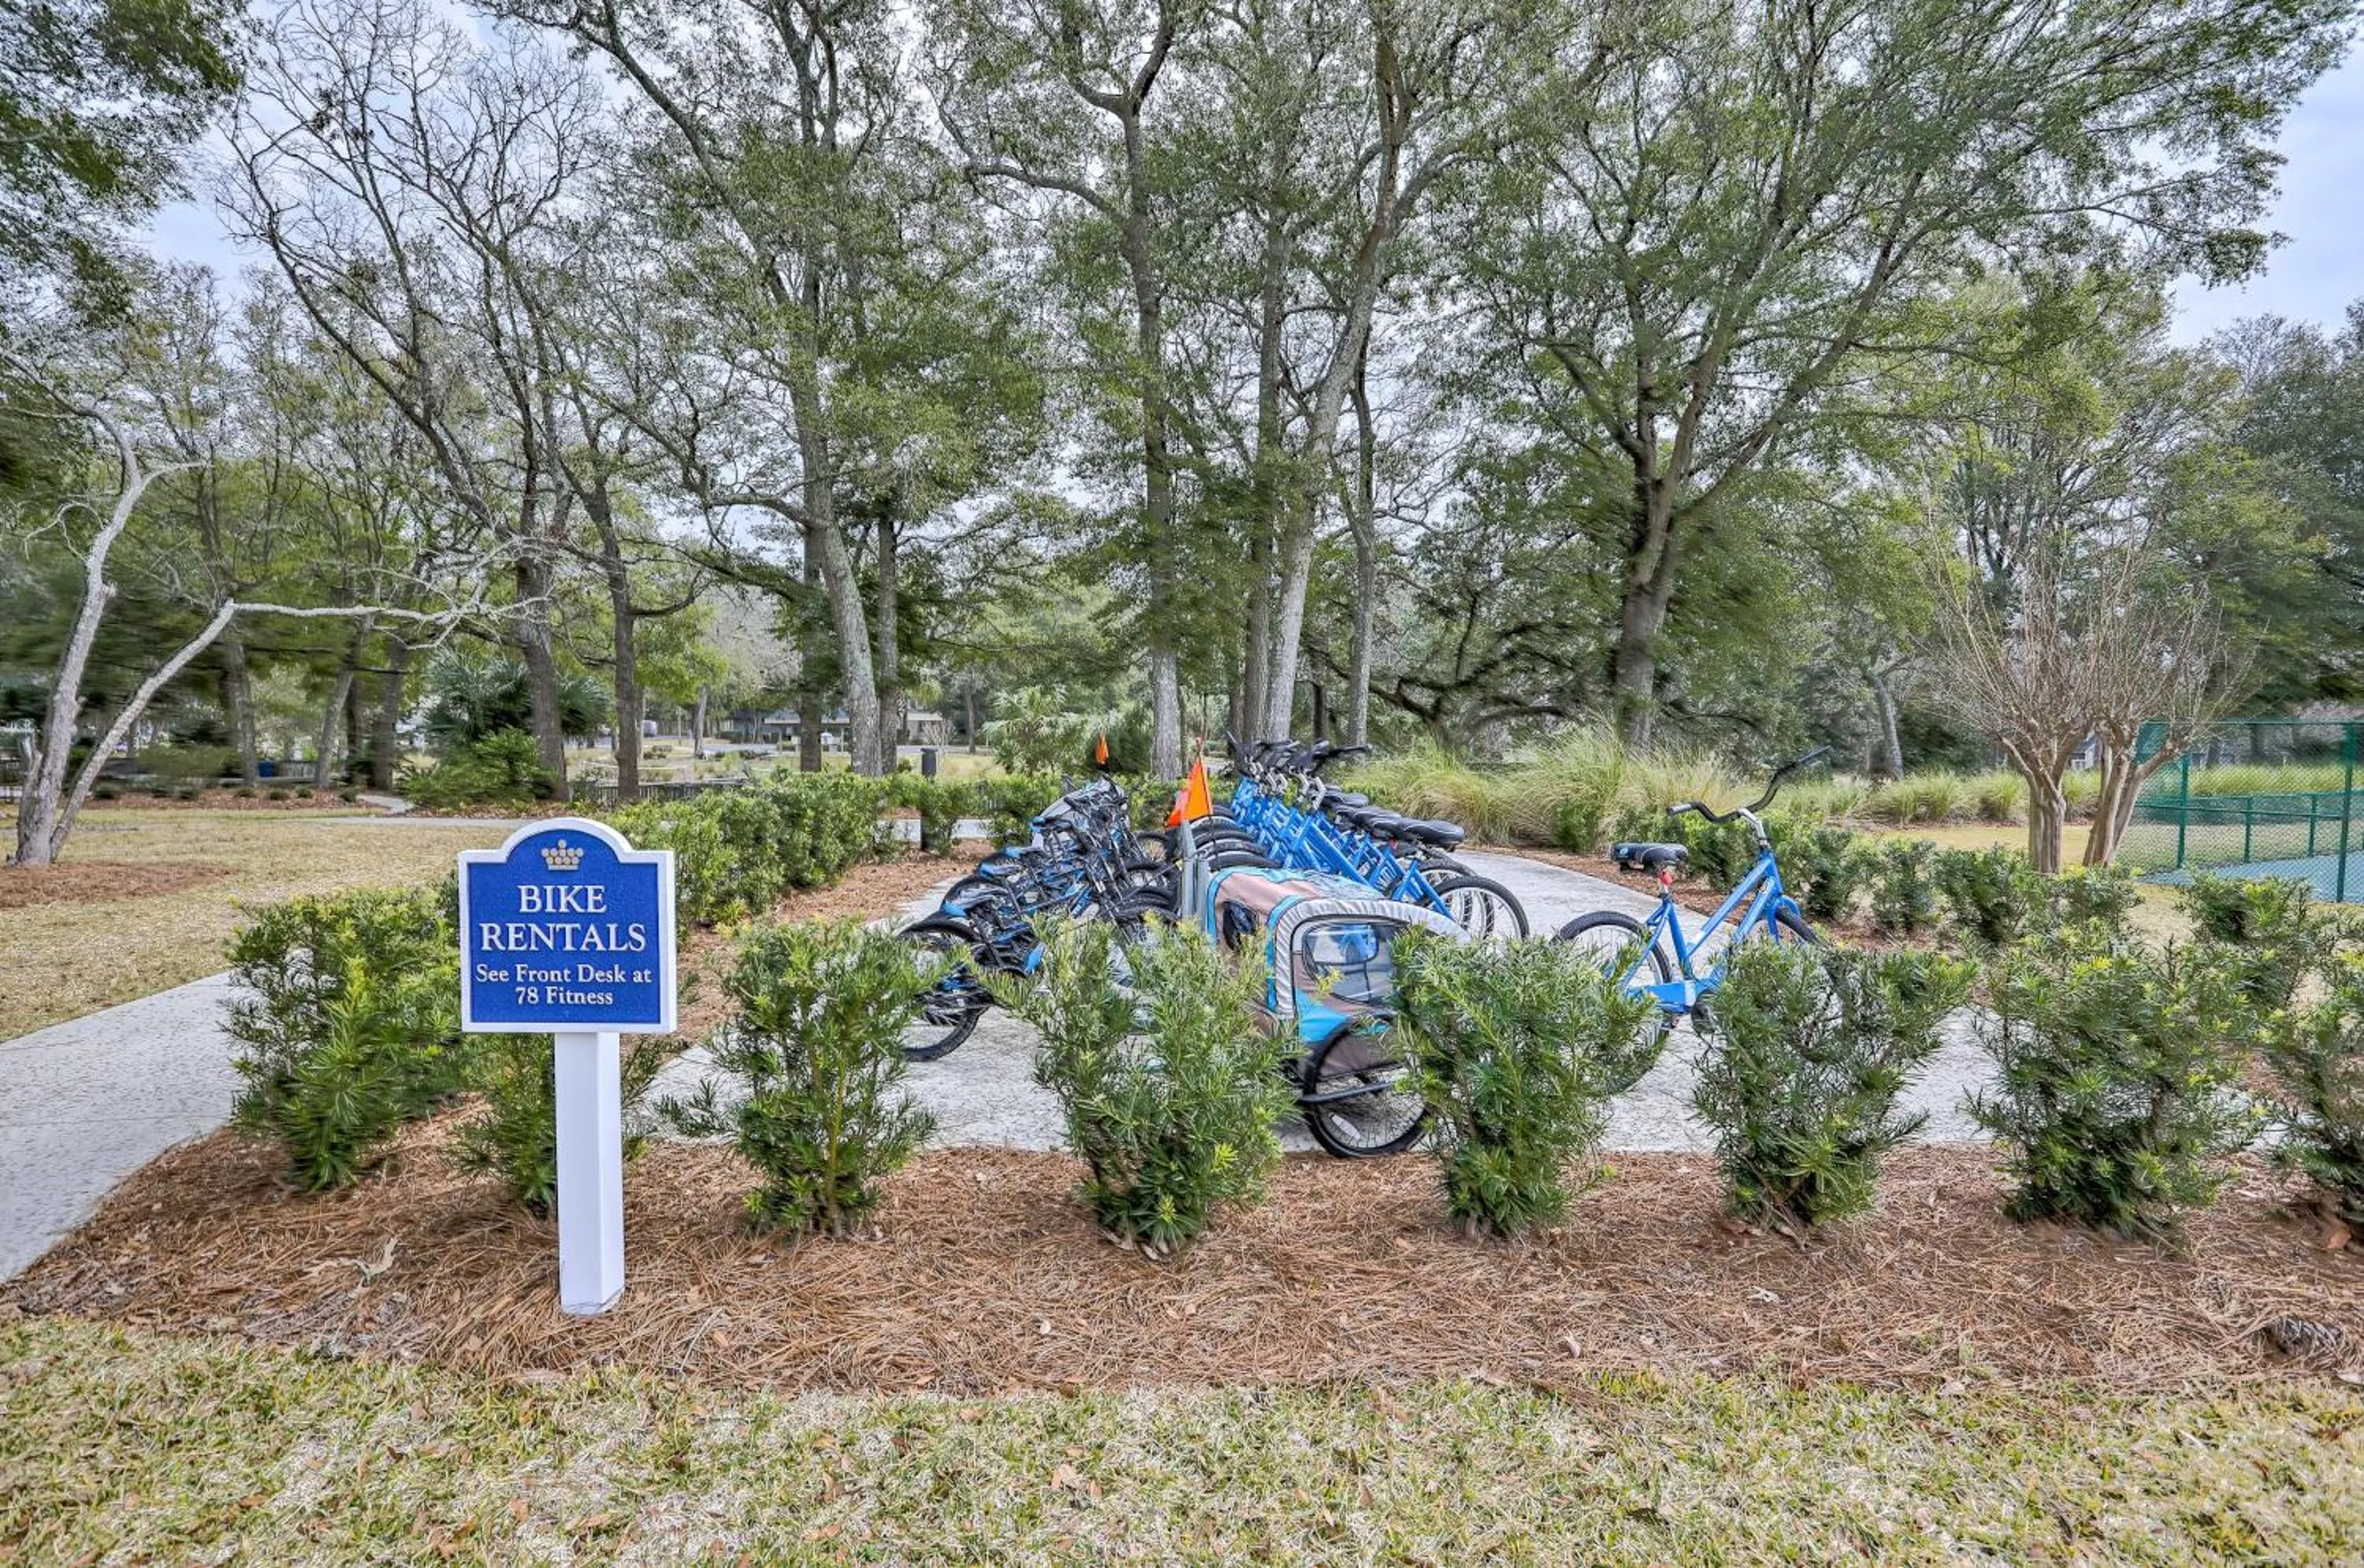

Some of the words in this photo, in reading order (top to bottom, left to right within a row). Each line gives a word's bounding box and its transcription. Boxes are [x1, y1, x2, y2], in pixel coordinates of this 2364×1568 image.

[517, 885, 606, 913] BIKE
[479, 923, 646, 952] RENTALS
[476, 964, 510, 983] See
[515, 964, 571, 983] Front
[578, 964, 626, 983] Desk
[633, 968, 652, 983] at
[515, 987, 540, 1005] 78
[546, 987, 614, 1005] Fitness
